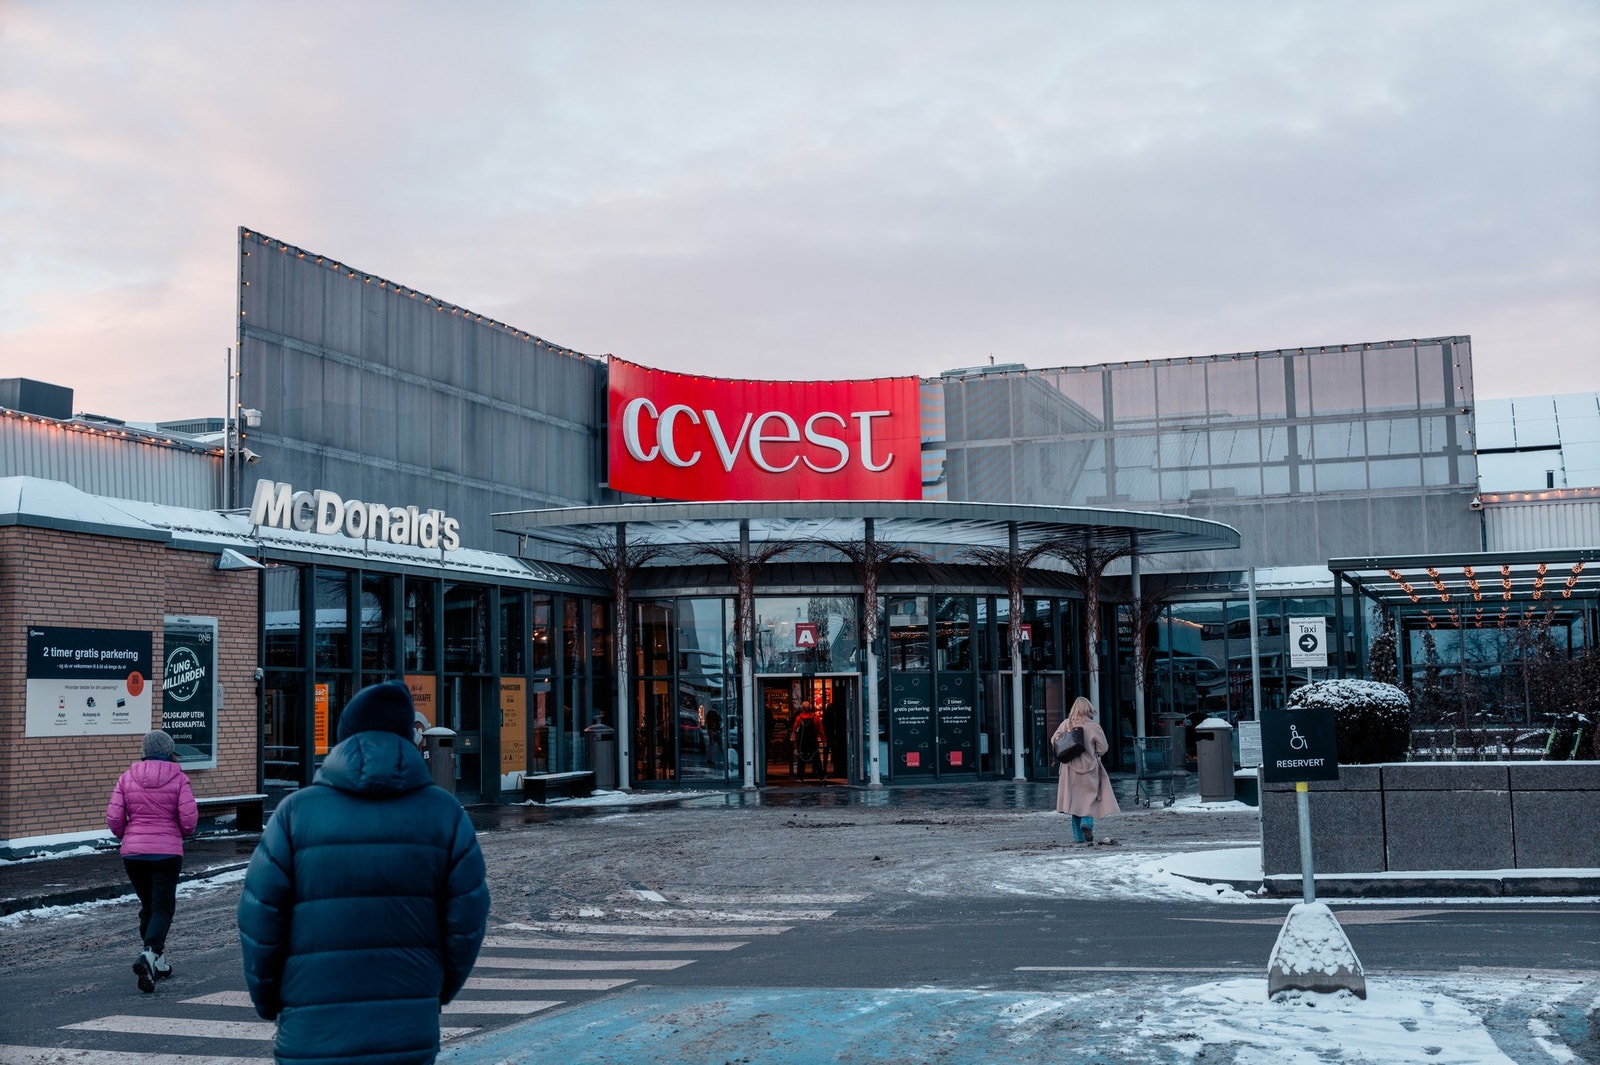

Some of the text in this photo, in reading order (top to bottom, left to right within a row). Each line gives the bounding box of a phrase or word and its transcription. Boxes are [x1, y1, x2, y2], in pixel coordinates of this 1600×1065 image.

[248, 478, 460, 551] McDonald's
[1299, 625, 1317, 633] Taxi
[198, 631, 211, 643] DNB
[798, 630, 814, 644] A
[43, 647, 139, 662] 2 timer gratis parkering
[173, 659, 190, 674] UNG
[162, 711, 205, 719] OLIGKJØP UTEN
[162, 720, 206, 729] ULL EGENKAPITAL
[1276, 758, 1325, 768] RESERVERT
